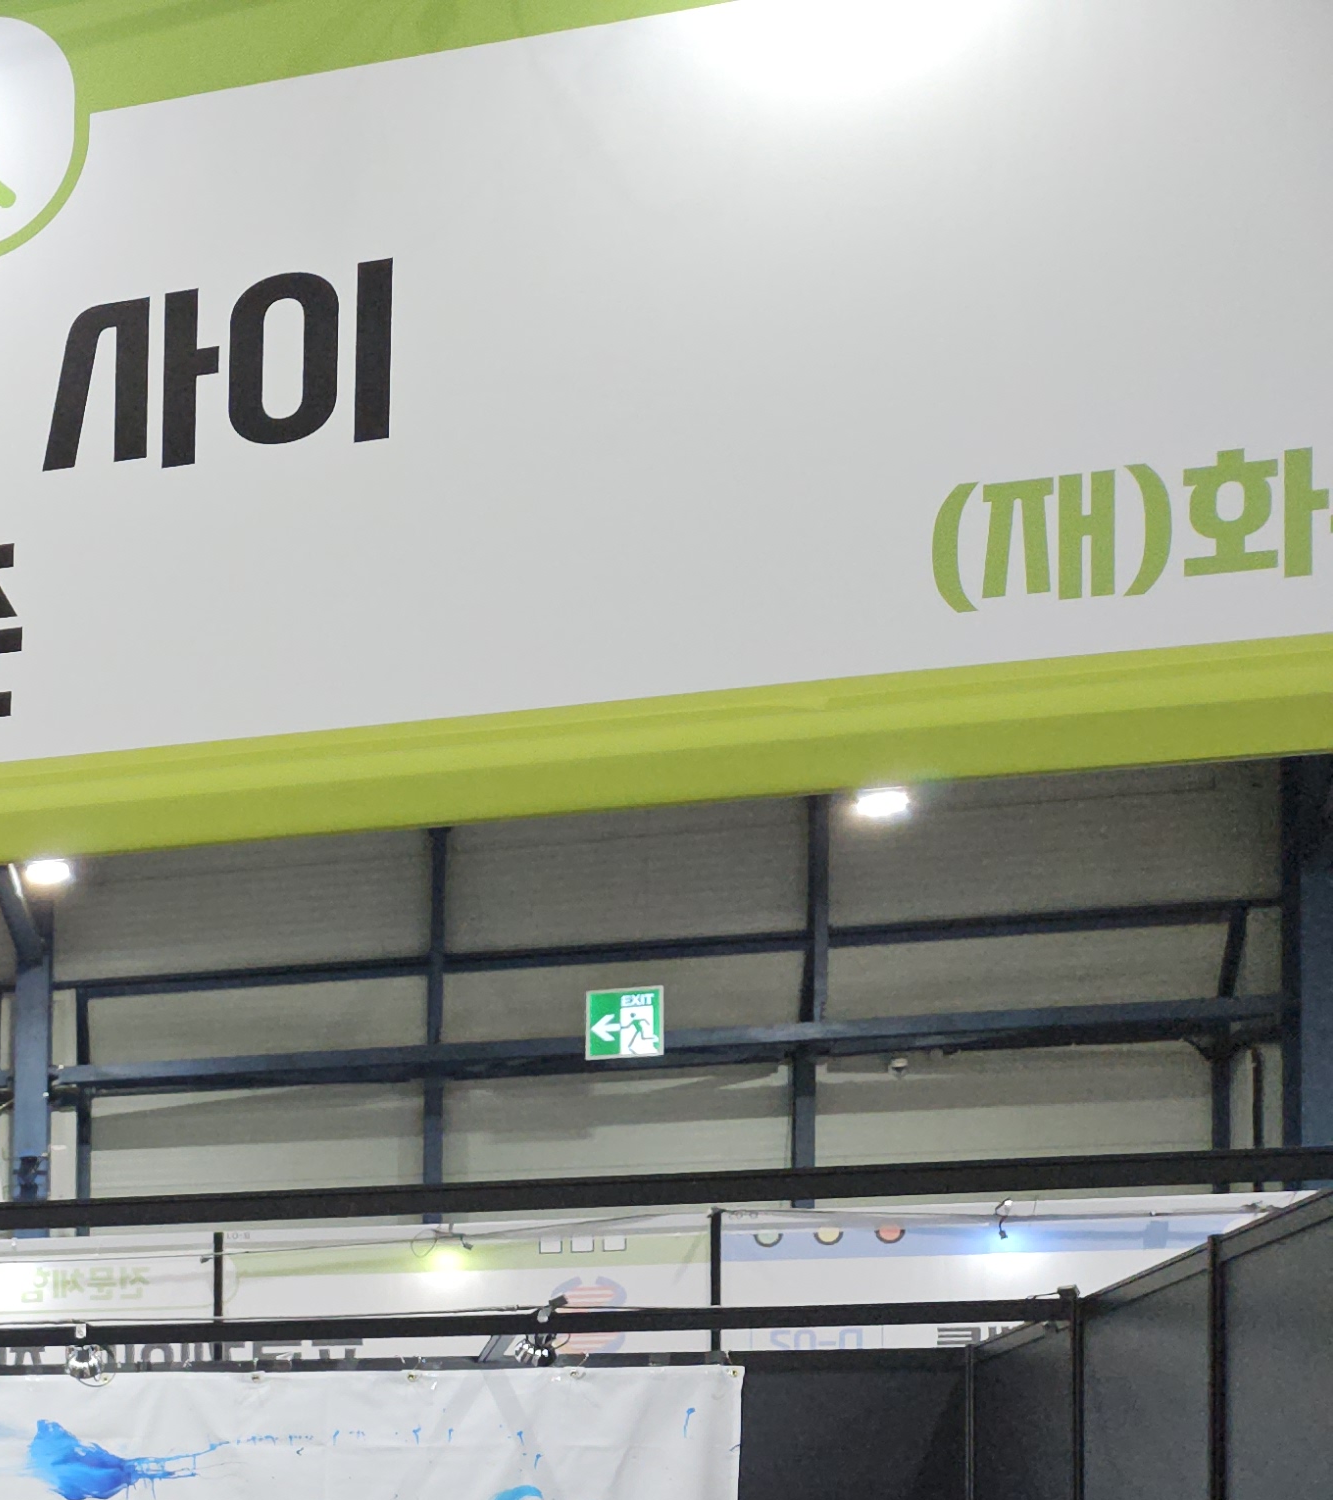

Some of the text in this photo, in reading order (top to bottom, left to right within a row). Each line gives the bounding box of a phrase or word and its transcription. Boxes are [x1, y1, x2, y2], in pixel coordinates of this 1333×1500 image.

[43, 258, 393, 472] 사이
[932, 447, 1333, 613] (재)화
[620, 993, 654, 1007] EXIT
